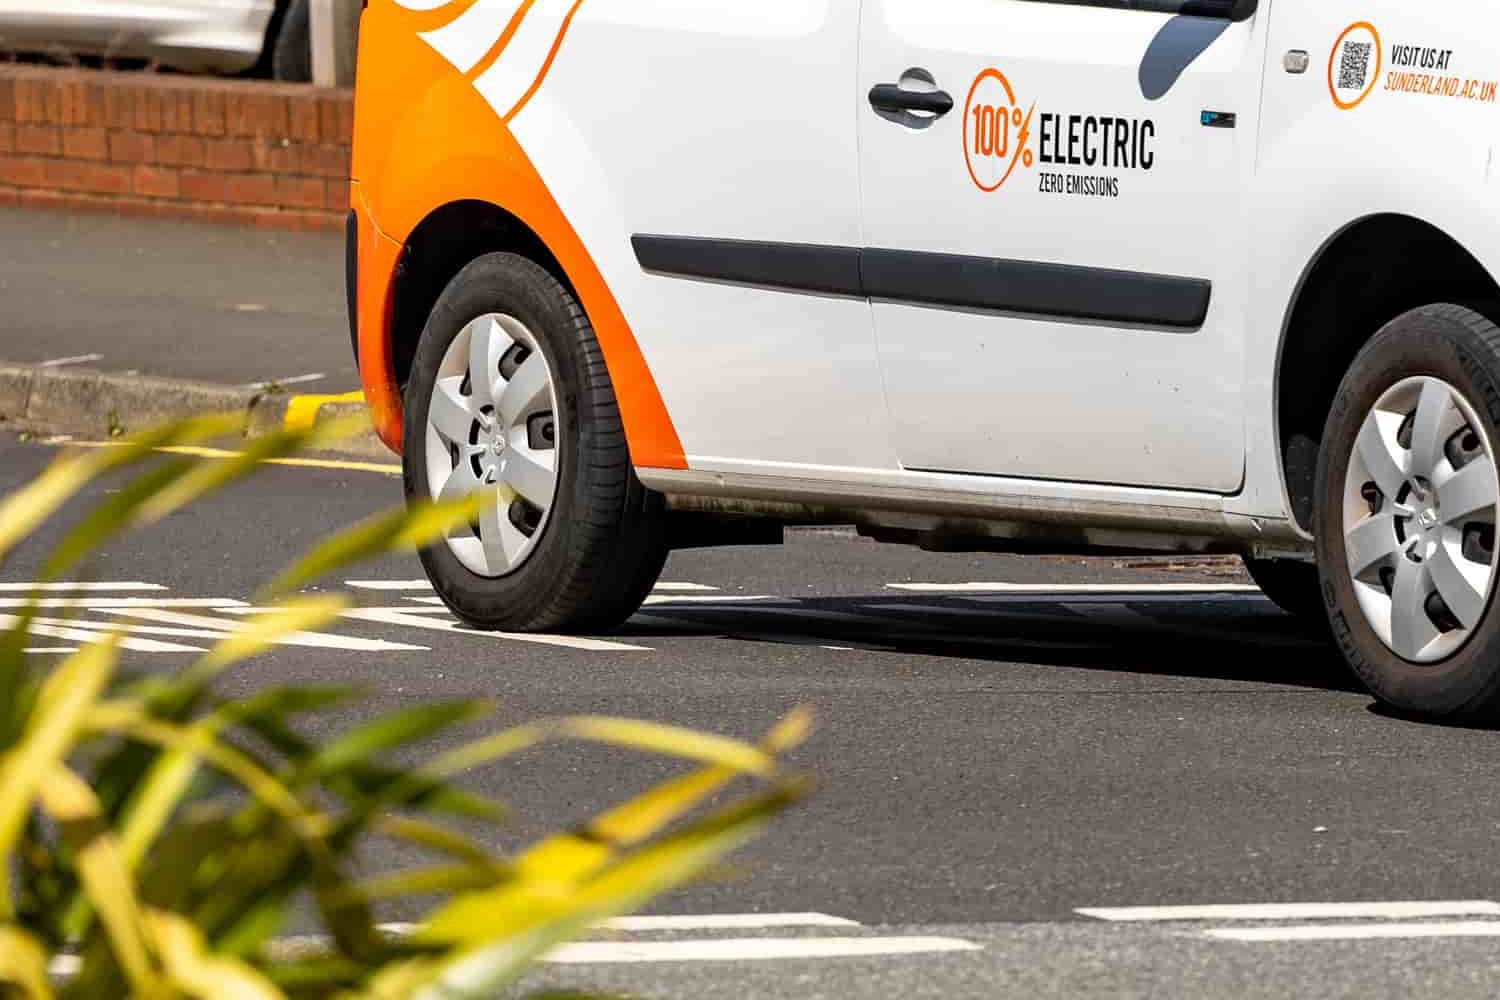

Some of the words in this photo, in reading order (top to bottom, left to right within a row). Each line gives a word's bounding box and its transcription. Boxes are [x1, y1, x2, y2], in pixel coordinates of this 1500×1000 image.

[1391, 44, 1420, 66] VISIT
[1419, 47, 1436, 69] US
[1436, 49, 1453, 70] AT
[1384, 71, 1498, 102] SUNDERLAND.AC.UK
[1039, 113, 1155, 170] ELECTRIC
[1039, 173, 1064, 194] ZERO
[1066, 174, 1119, 198] EMISSIONS
